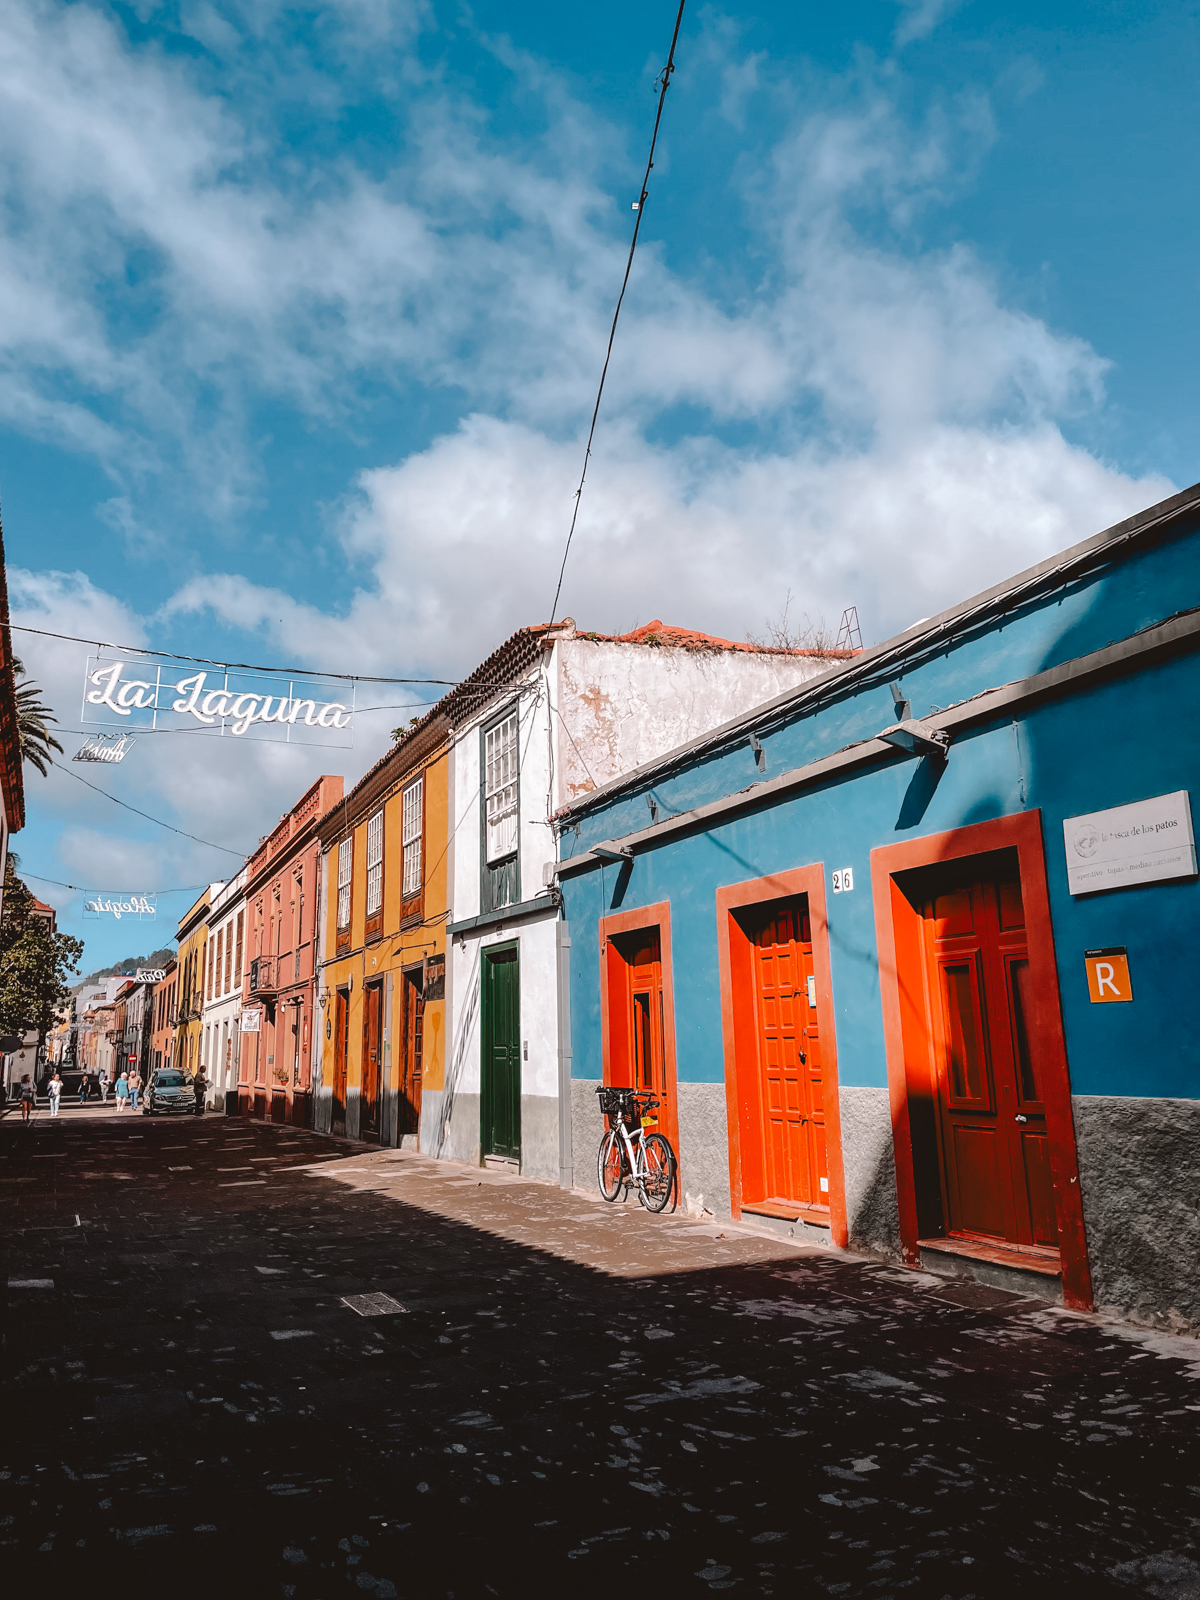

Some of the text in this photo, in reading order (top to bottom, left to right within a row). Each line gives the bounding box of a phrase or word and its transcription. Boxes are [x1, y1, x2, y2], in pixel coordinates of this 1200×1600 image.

[87, 662, 351, 735] La Laguna
[1130, 826, 1141, 837] de
[1142, 824, 1154, 834] los
[1155, 819, 1178, 833] patos
[833, 873, 850, 890] 26
[1095, 962, 1121, 996] R
